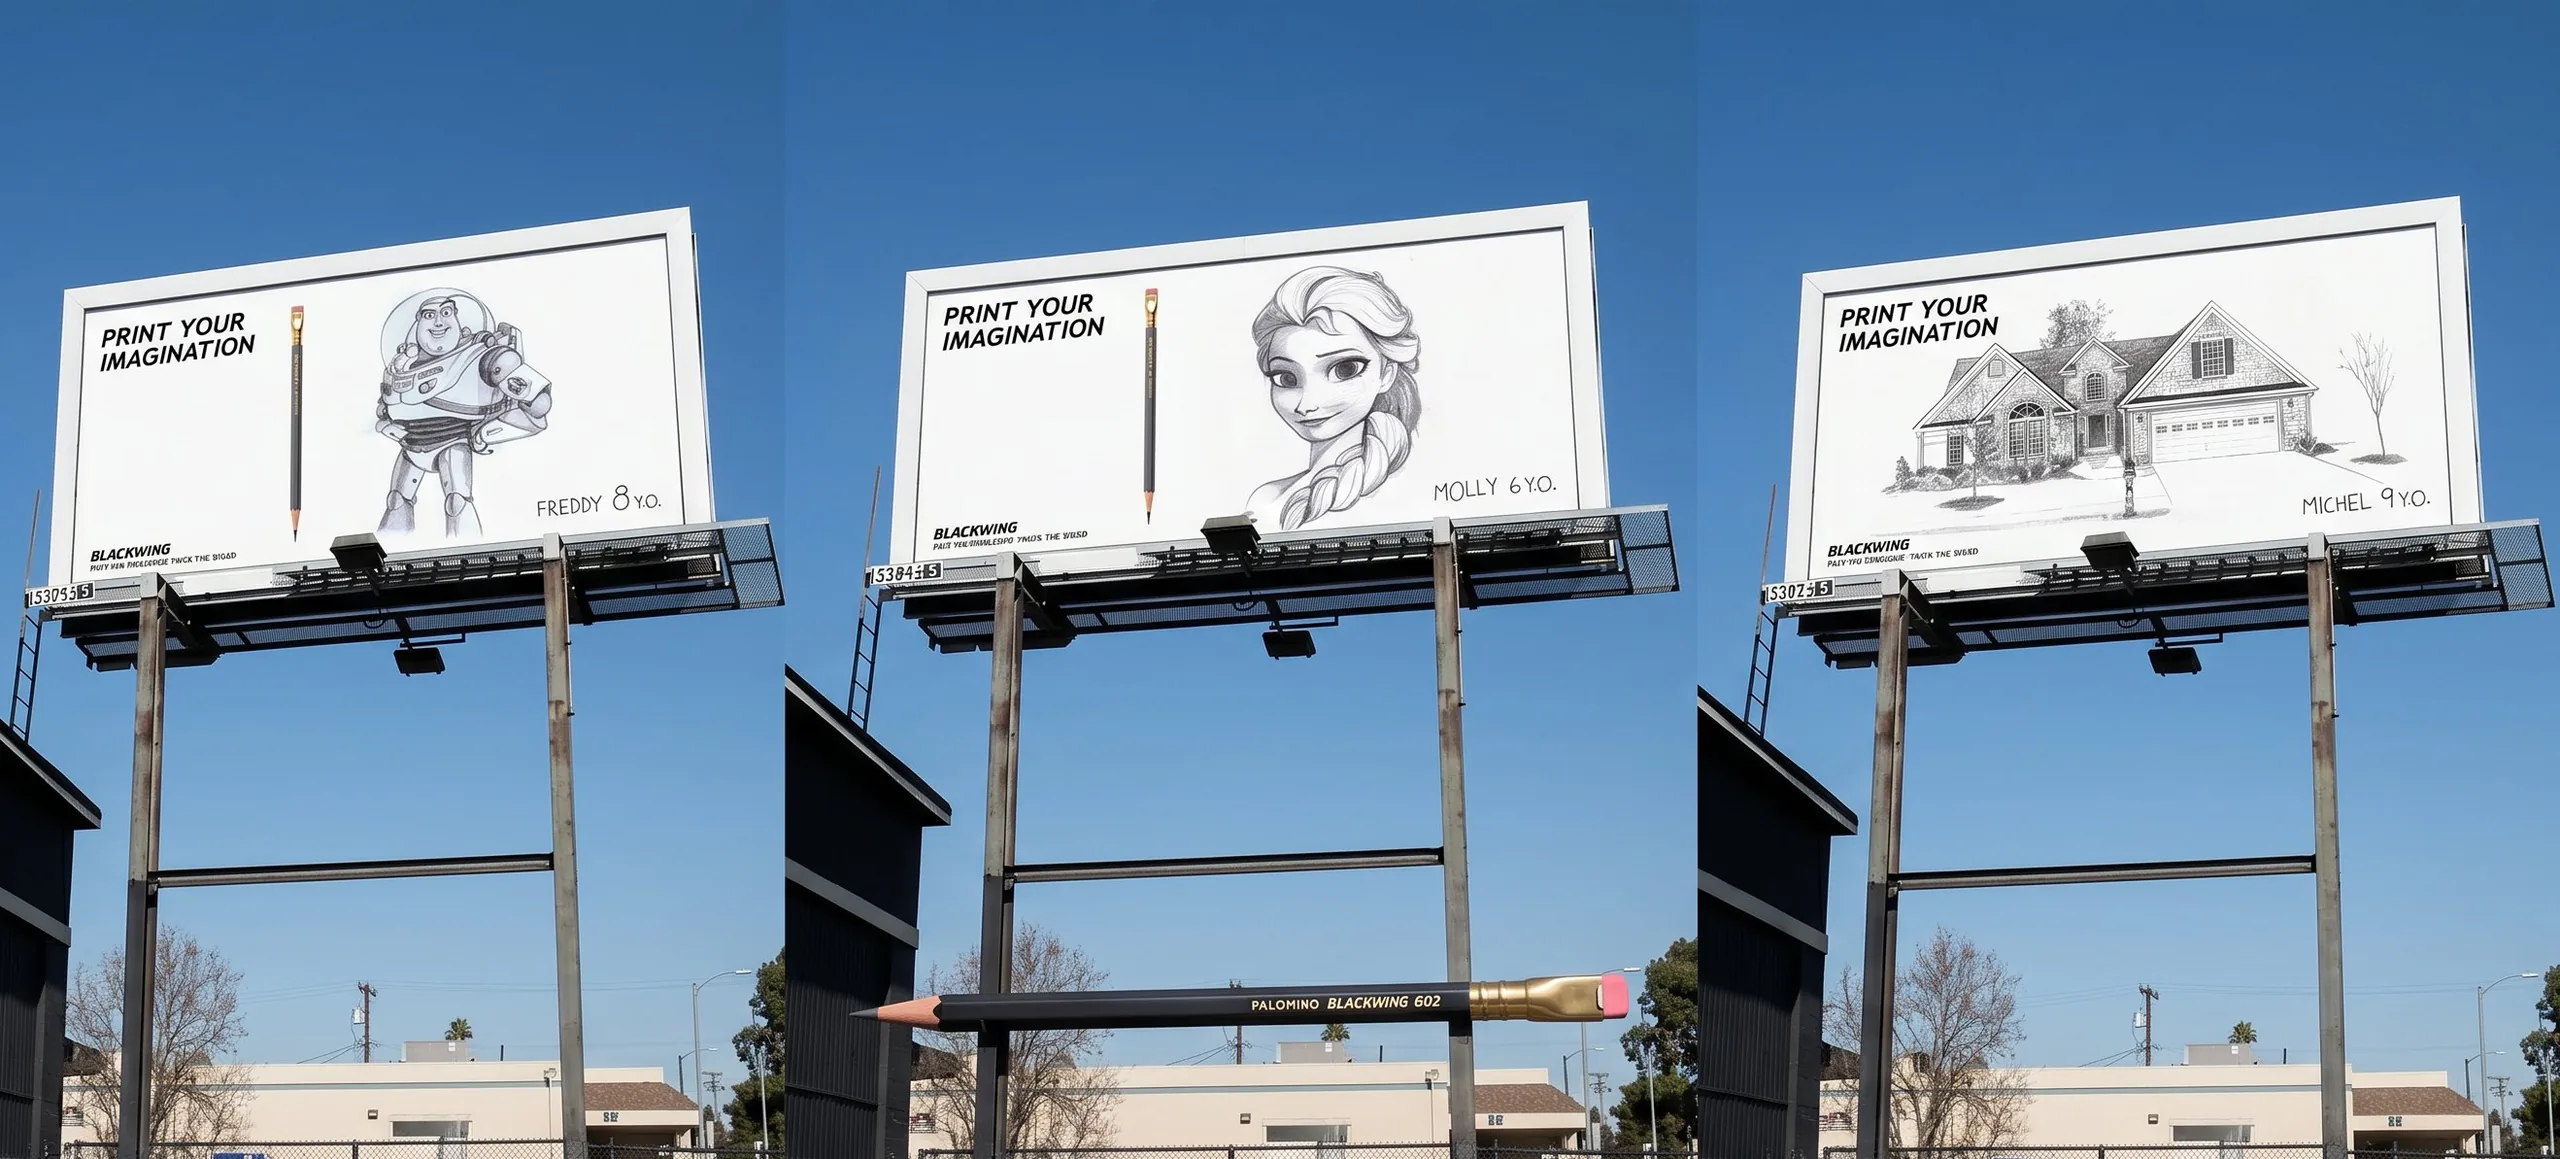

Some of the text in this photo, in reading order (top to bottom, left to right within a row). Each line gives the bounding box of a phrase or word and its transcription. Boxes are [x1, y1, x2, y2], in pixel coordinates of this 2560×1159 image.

[944, 293, 1094, 326] PRINT YOUR
[1840, 294, 1988, 328] PRINT YOUR
[101, 312, 245, 348] PRINT YOUR
[942, 316, 1105, 351] IMAGINATION
[1839, 316, 1999, 352] IMAGINATION
[100, 334, 256, 372] IMAGINATION
[537, 484, 662, 517] FREDDY 8 Y.O.
[1434, 477, 1498, 502] MOLLY
[2303, 487, 2431, 515] MICHEL 9 Y.O.
[933, 521, 1018, 540] BLACKWING
[1045, 532, 1061, 541] THE
[90, 543, 171, 562] BLACKWING
[1827, 538, 1910, 557] BLACKWING
[1251, 995, 1441, 1011] PALOMINO BLACKWING 602
